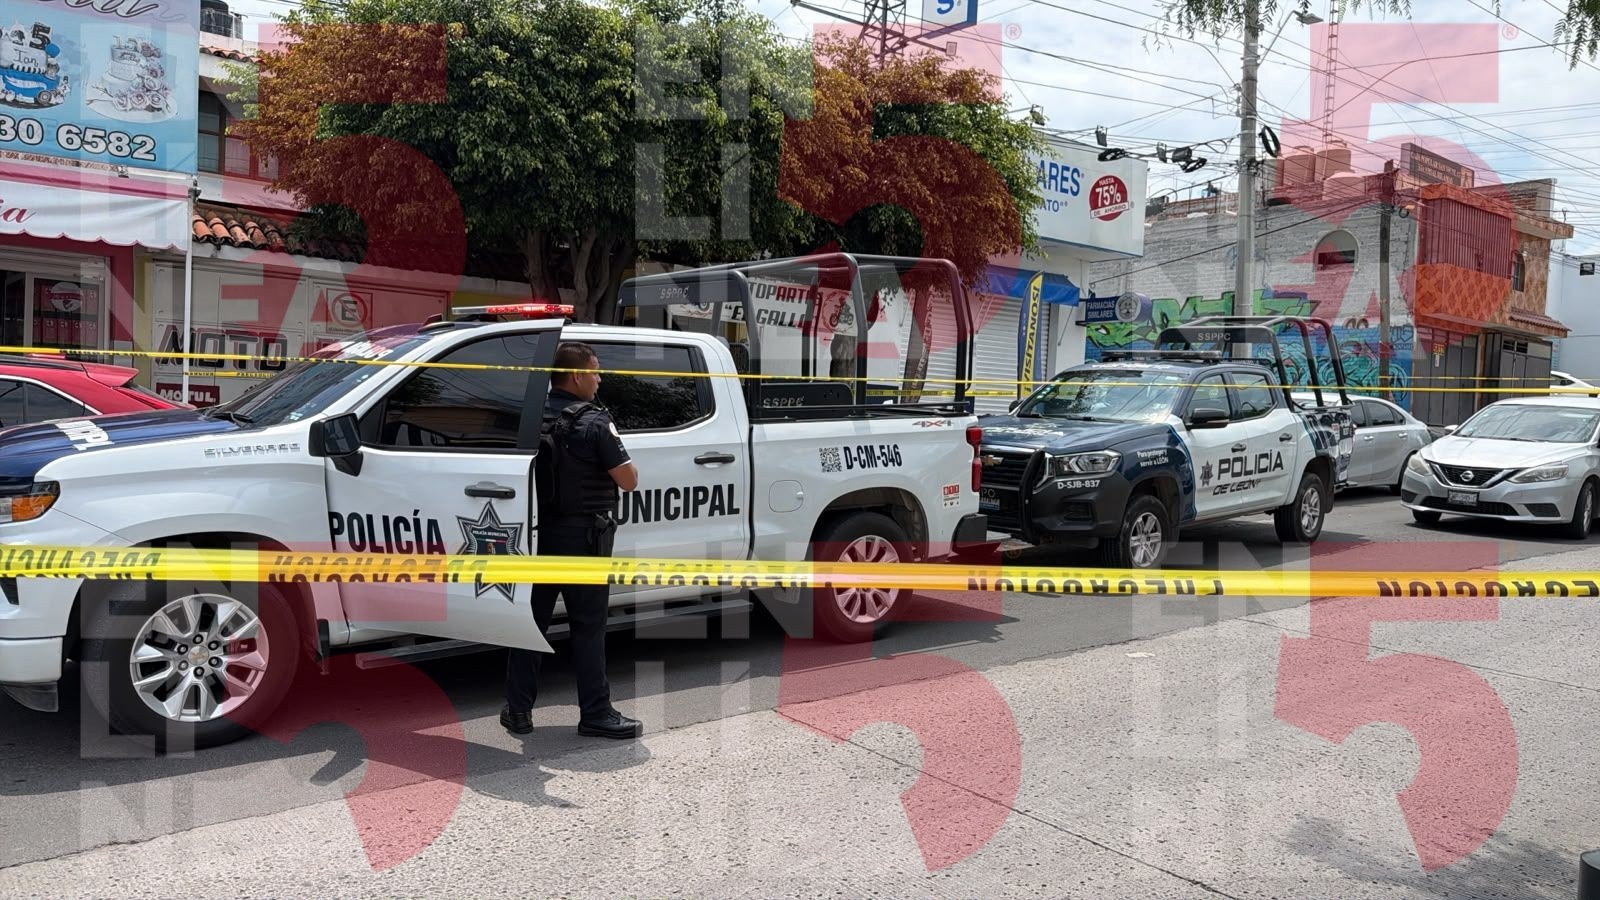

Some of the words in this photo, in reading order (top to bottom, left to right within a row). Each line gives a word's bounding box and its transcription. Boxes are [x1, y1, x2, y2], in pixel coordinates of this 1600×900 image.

[56, 124, 157, 162] 6582
[1036, 159, 1081, 197] ARES
[1098, 178, 1115, 186] HASTA
[1095, 184, 1122, 208] 75%
[1104, 204, 1127, 216] AHORRO
[1086, 300, 1115, 310] FARMACIAS
[1087, 309, 1114, 319] SIMILARES
[1197, 332, 1232, 342] SSPPC
[843, 443, 903, 470] D-CM-546
[1217, 449, 1284, 481] POLICÍA
[1057, 480, 1101, 489] D-SJB-837
[1213, 483, 1231, 496] DE
[616, 483, 741, 526] UNICIPAL
[328, 508, 447, 556] POLICÍA
